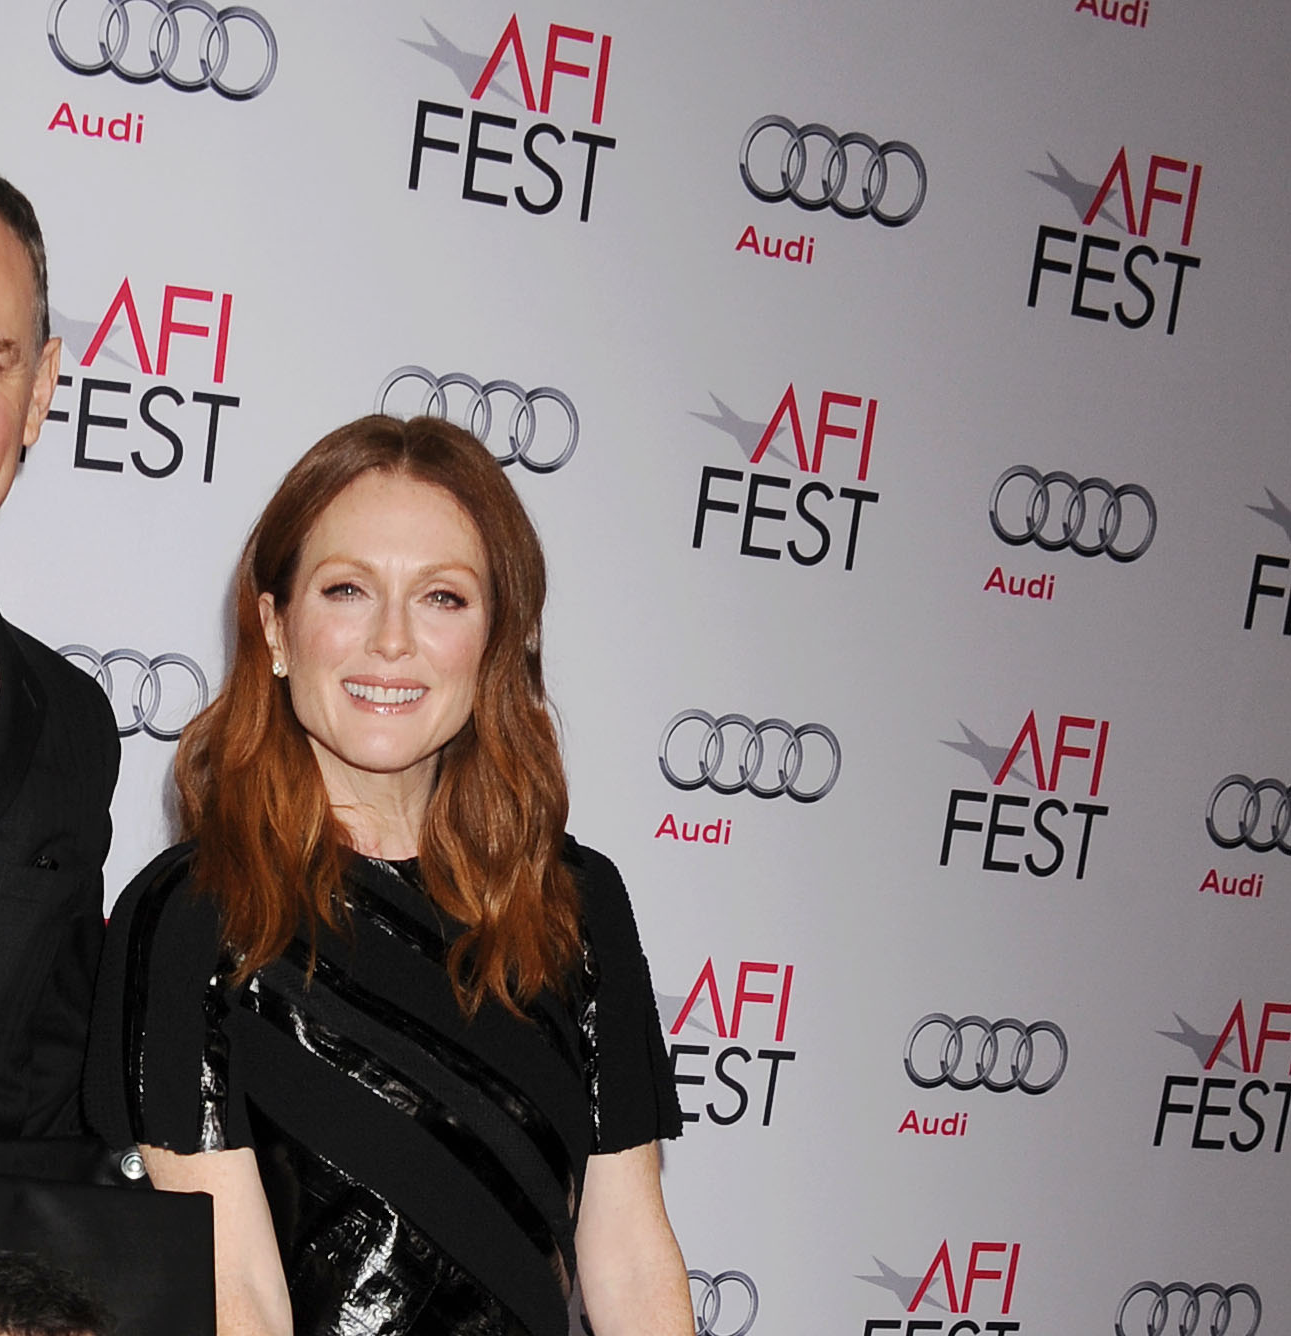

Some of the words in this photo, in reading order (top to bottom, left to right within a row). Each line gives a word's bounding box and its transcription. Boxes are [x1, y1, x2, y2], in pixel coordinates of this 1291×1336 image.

[1076, 0, 1148, 27] Audi
[470, 15, 612, 125] AFI
[48, 103, 143, 144] Audi
[409, 100, 616, 222] FEST
[1083, 147, 1202, 246] AFI
[736, 226, 814, 264] Audi
[1028, 225, 1200, 334] FEST
[80, 278, 232, 384] AFI
[46, 375, 240, 482] EST
[750, 384, 878, 481] AFI
[693, 466, 879, 570] FEST
[985, 568, 1054, 600] Audi
[994, 712, 1110, 797] AFI
[655, 814, 731, 844] Audi
[940, 789, 1108, 879] FEST
[1199, 869, 1261, 897] Audi
[670, 959, 794, 1042] AFI
[1204, 1000, 1291, 1074] AF
[669, 1044, 796, 1126] EST
[900, 1110, 966, 1136] Audi
[908, 1241, 1020, 1314] AFI
